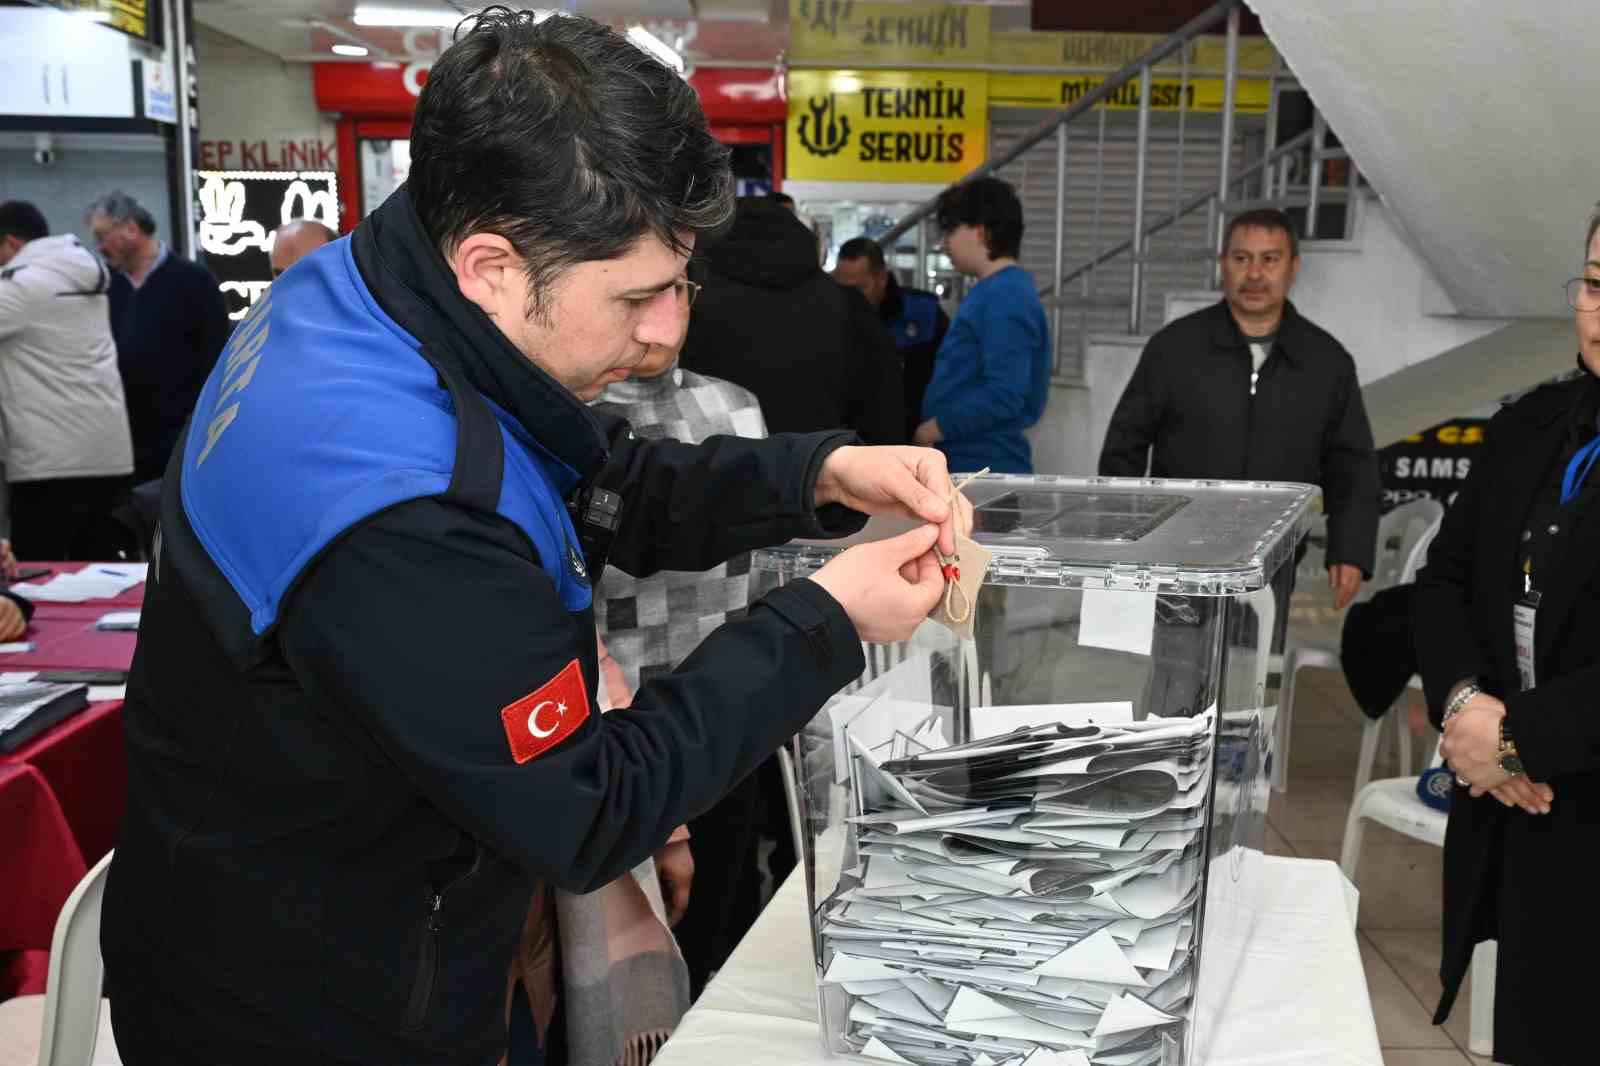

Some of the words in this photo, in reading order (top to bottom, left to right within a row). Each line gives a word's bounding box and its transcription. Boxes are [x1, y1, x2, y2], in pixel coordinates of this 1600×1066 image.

[863, 80, 964, 118] TEKNİK
[200, 141, 232, 169] EP
[1395, 456, 1471, 480] SAMS
